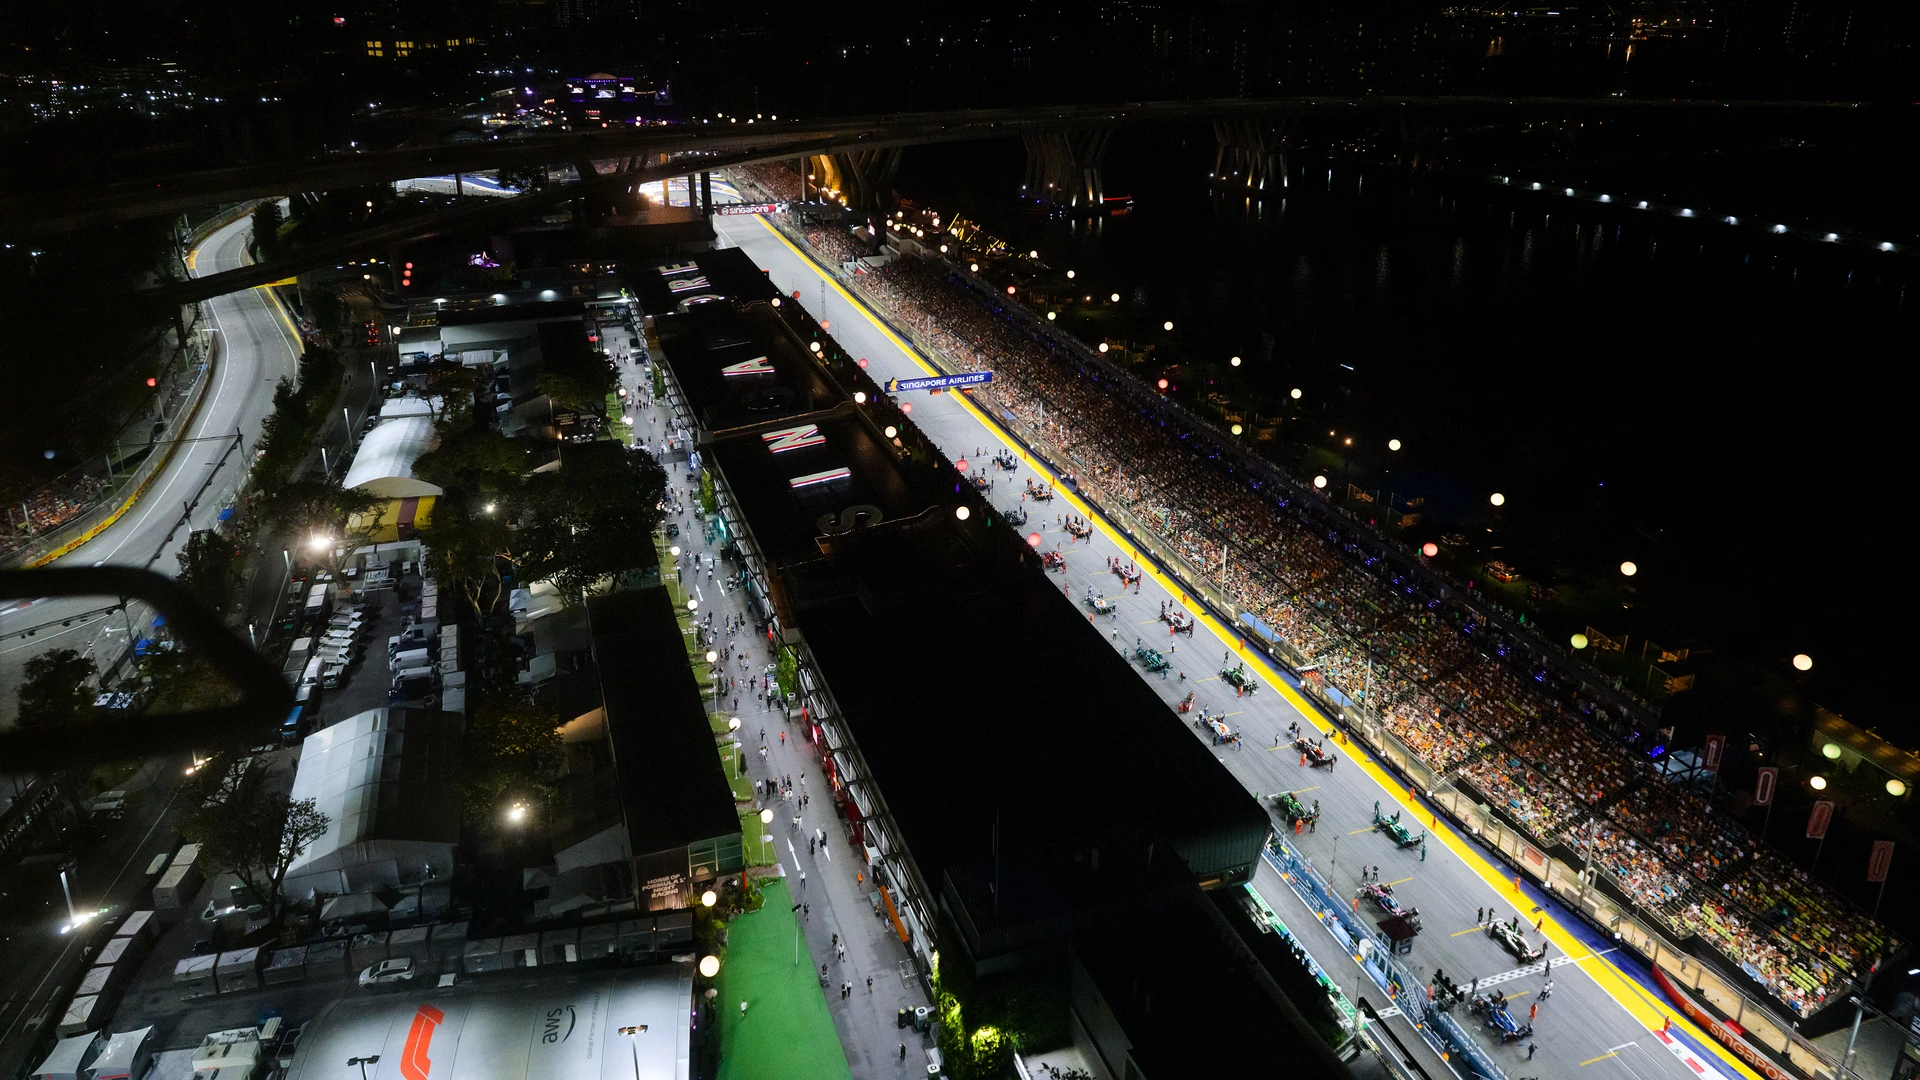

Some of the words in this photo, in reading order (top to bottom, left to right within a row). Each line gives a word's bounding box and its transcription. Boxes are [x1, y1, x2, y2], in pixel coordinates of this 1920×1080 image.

[900, 378, 946, 390] SINGAPORE
[948, 374, 985, 385] AIRLINES
[642, 879, 679, 891] FORMULA
[653, 884, 676, 893] NIGHT
[651, 888, 679, 898] RACING
[542, 1008, 563, 1045] aws
